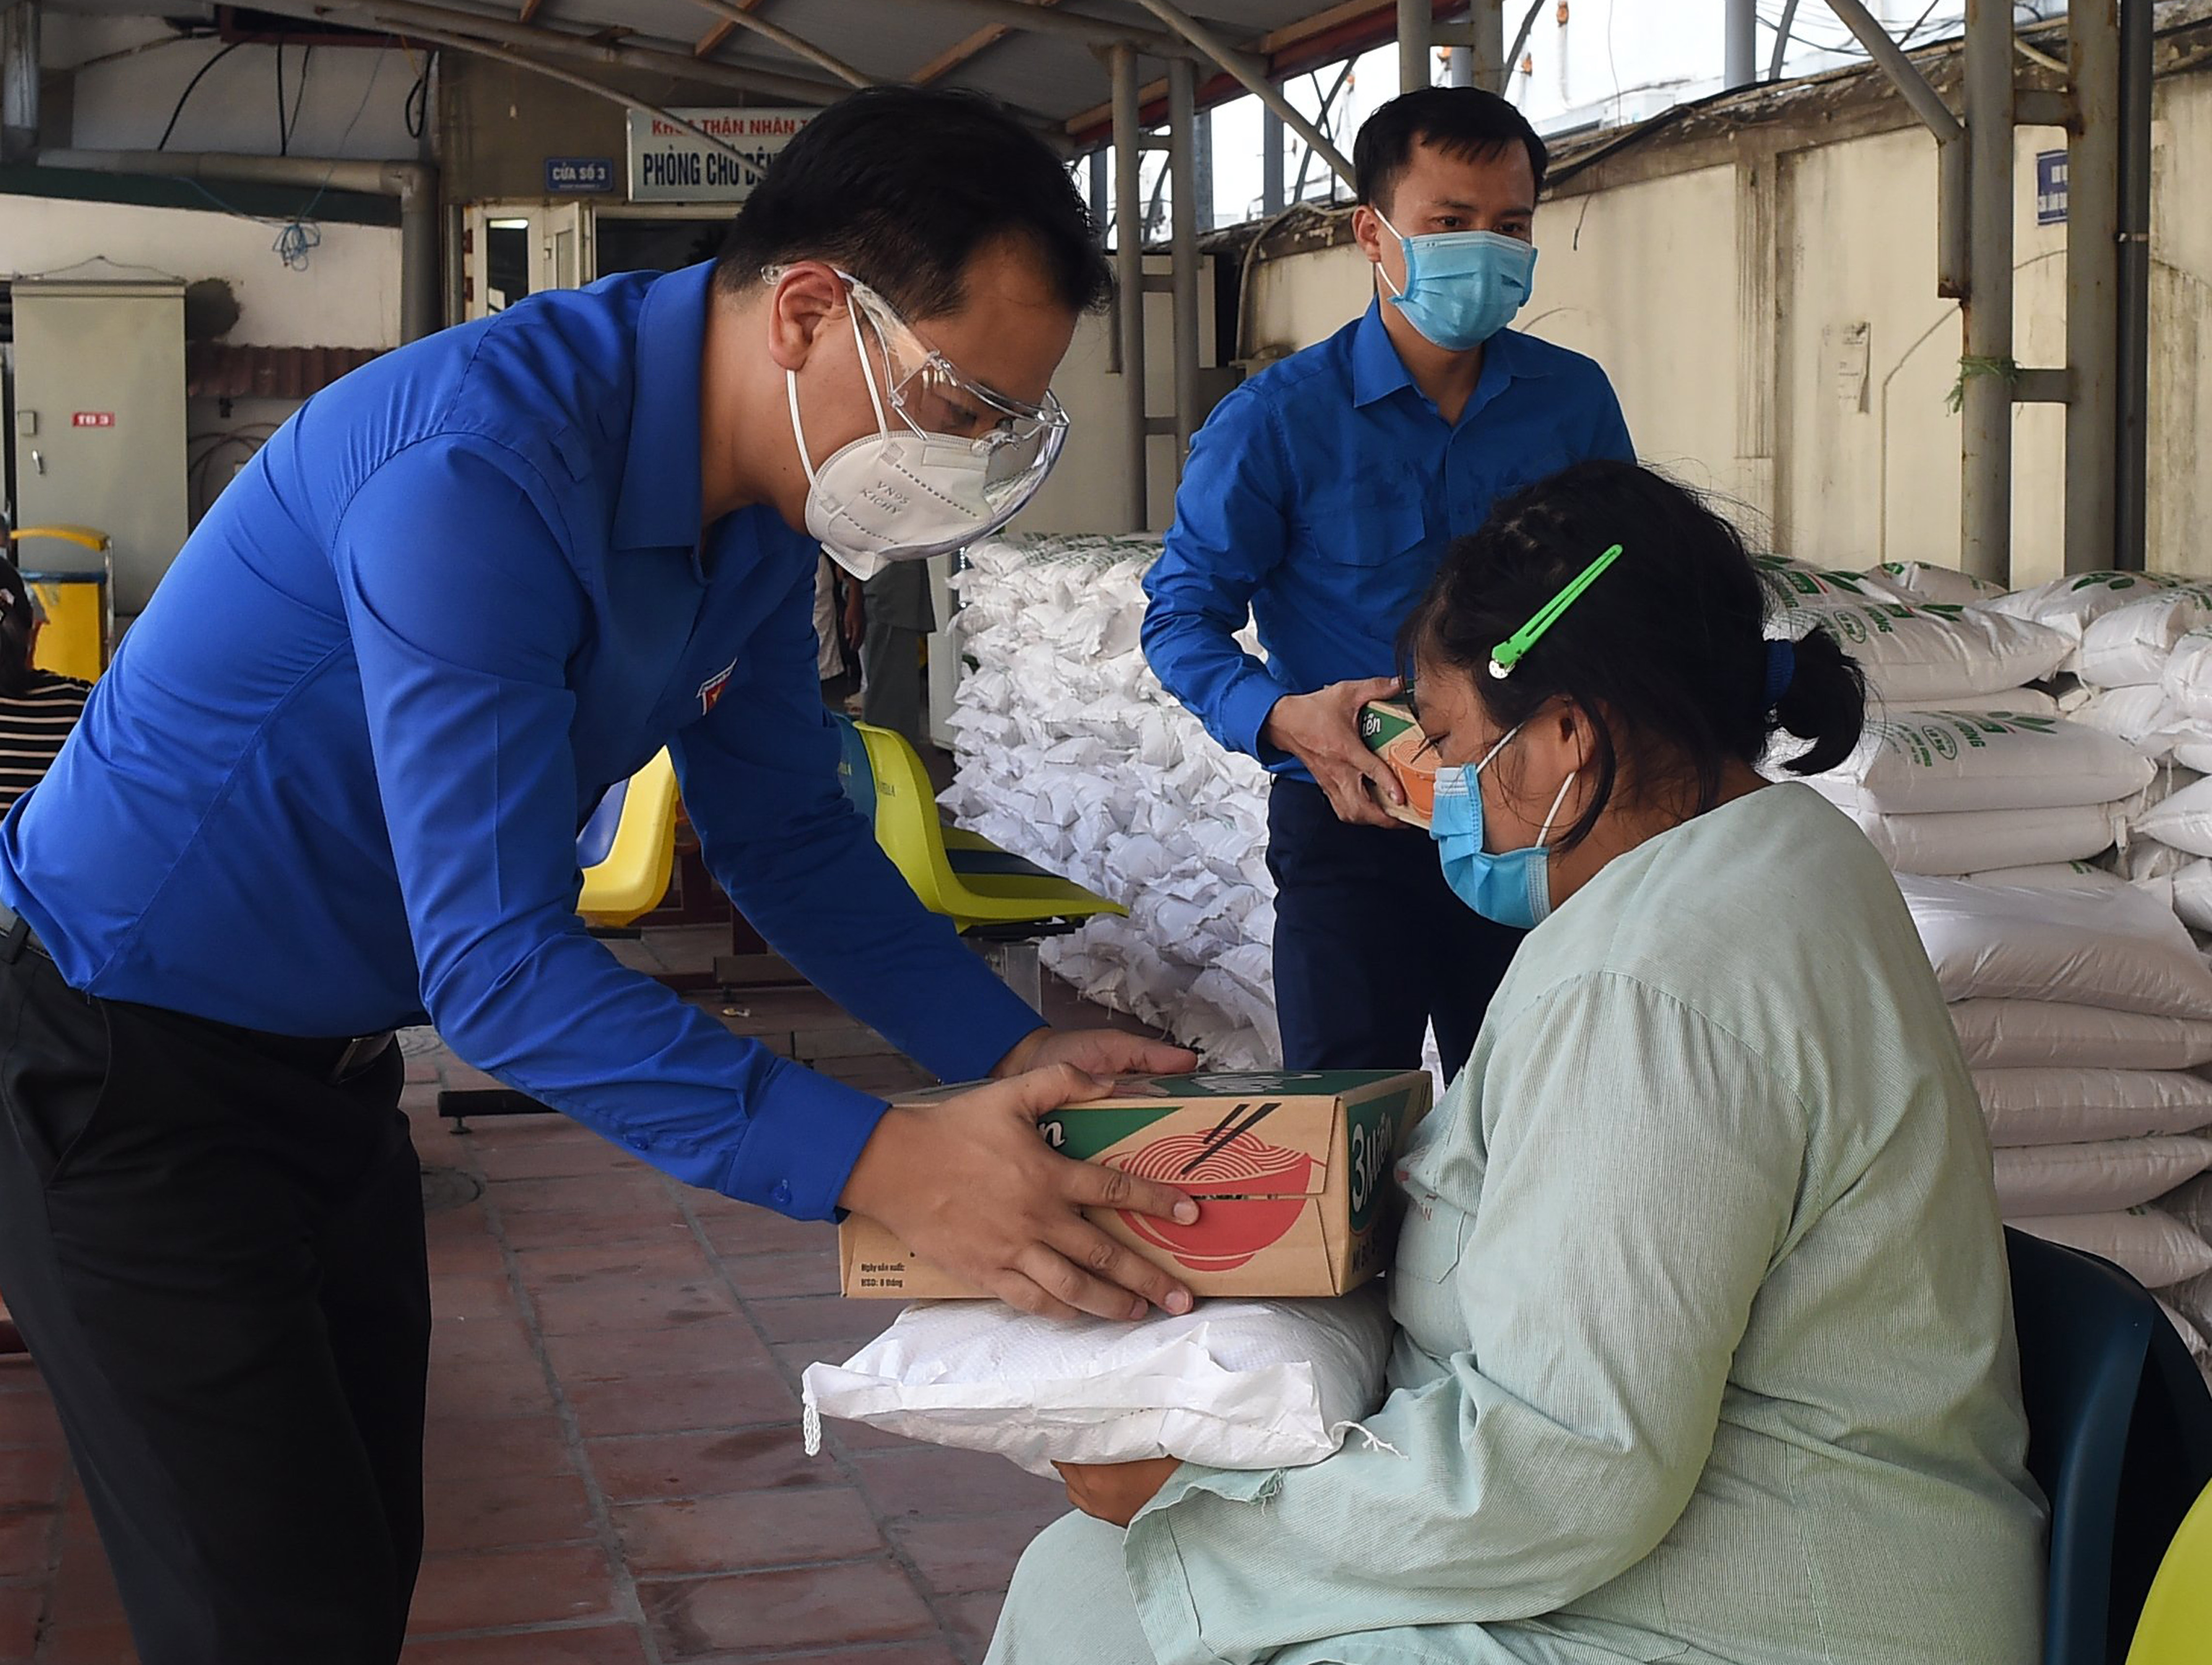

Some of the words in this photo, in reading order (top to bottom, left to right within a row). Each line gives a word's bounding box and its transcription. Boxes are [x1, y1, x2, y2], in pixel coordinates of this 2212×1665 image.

[702, 116, 744, 137] THẬN
[750, 117, 795, 135] NHÂN
[553, 162, 576, 180] CỬA
[579, 163, 595, 180] SỐ
[598, 167, 605, 180] 3
[643, 144, 700, 186] PHÒNG
[877, 480, 910, 504] VN95
